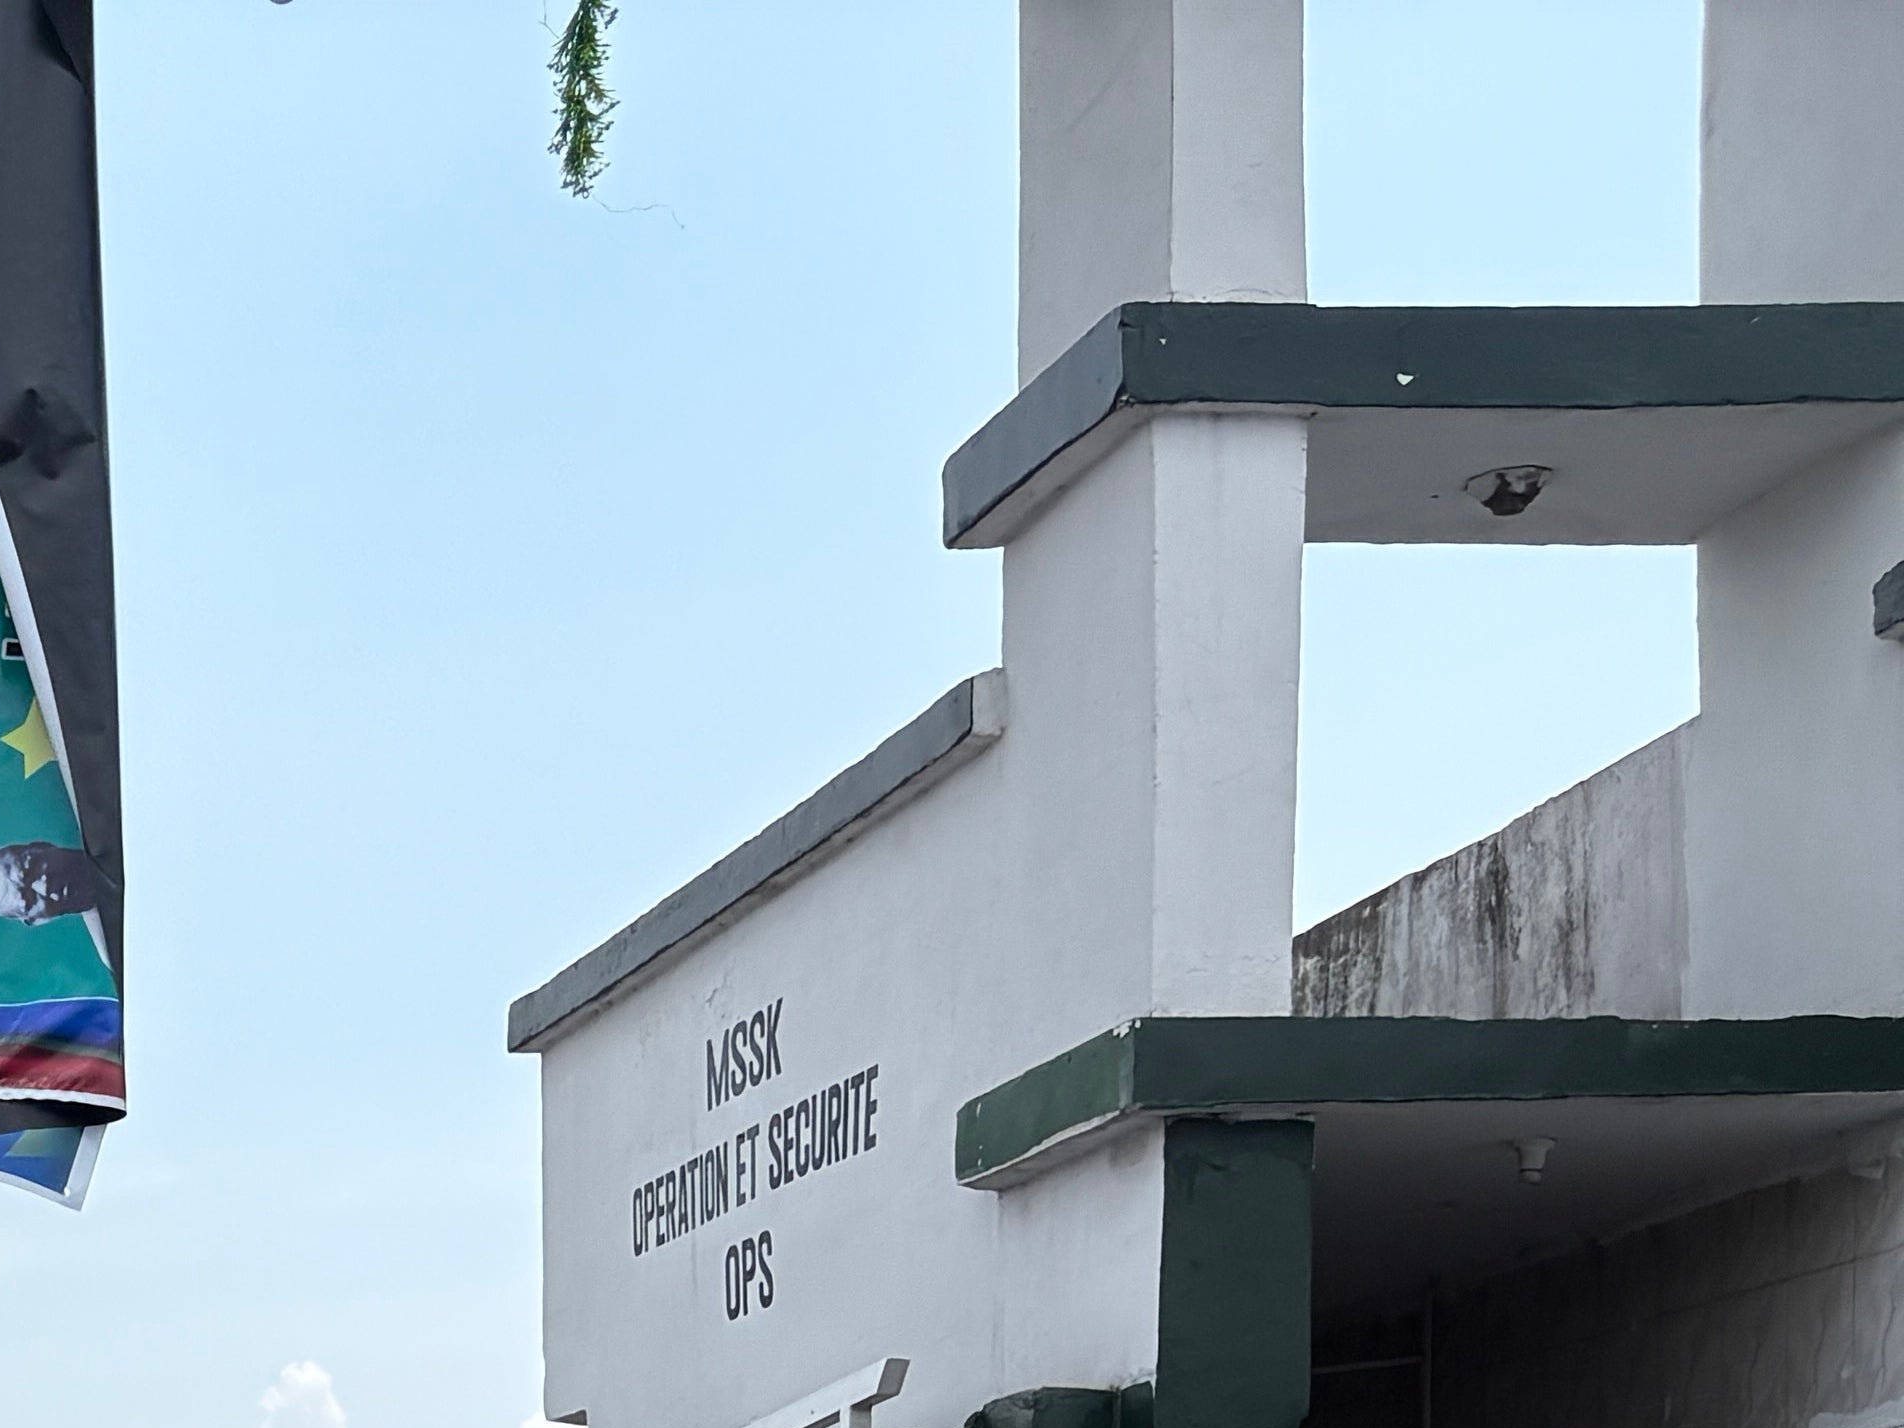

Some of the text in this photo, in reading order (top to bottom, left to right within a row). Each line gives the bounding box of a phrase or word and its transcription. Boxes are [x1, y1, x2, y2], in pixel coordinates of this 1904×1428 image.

[706, 997, 784, 1111] MSSK
[633, 1064, 880, 1257] OPERATION ET SECURITE
[725, 1230, 774, 1321] OPS
